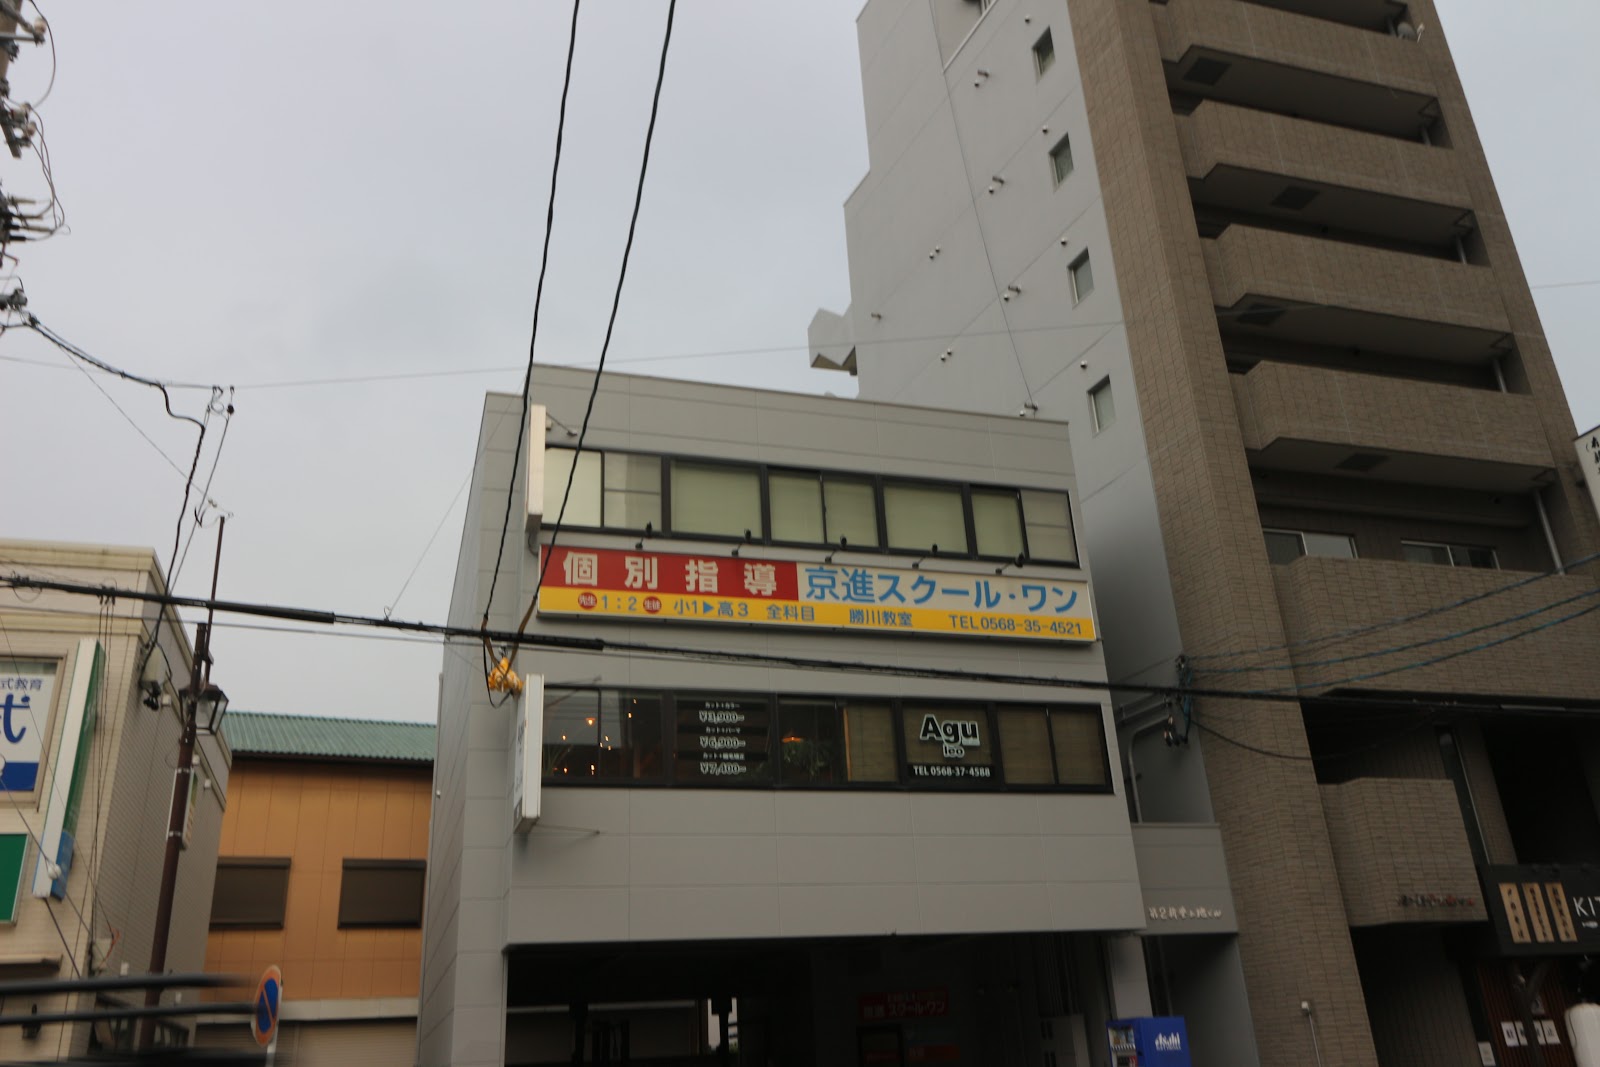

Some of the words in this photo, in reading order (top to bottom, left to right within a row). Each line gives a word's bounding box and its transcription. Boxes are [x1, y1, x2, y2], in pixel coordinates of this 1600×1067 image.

[563, 551, 777, 596] 個別指導
[804, 566, 1078, 614] 京進スクール・ワン
[767, 604, 816, 622] 全科目
[849, 608, 913, 627] 勝川教室
[980, 617, 1082, 635] 0568-35-4521
[919, 713, 980, 746] Agu
[943, 743, 965, 758] leo
[913, 765, 930, 776] TEL
